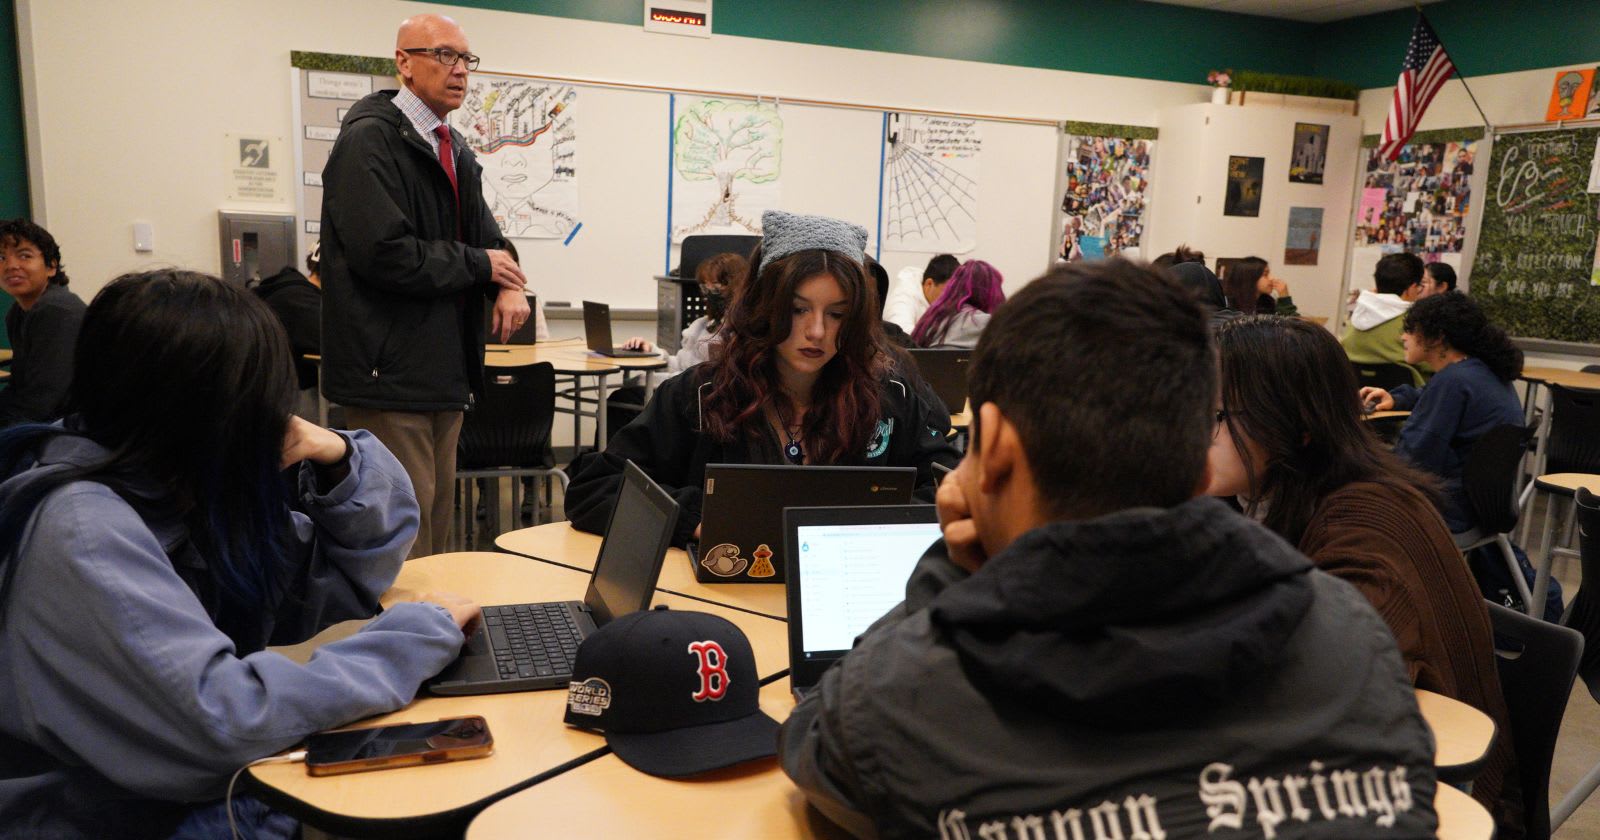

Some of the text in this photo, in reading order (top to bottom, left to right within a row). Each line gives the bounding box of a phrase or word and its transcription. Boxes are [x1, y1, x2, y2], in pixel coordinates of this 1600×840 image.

[569, 683, 607, 696] WORLD
[688, 640, 731, 703] B
[569, 694, 609, 705] SERIES
[1199, 760, 1414, 838] Springs
